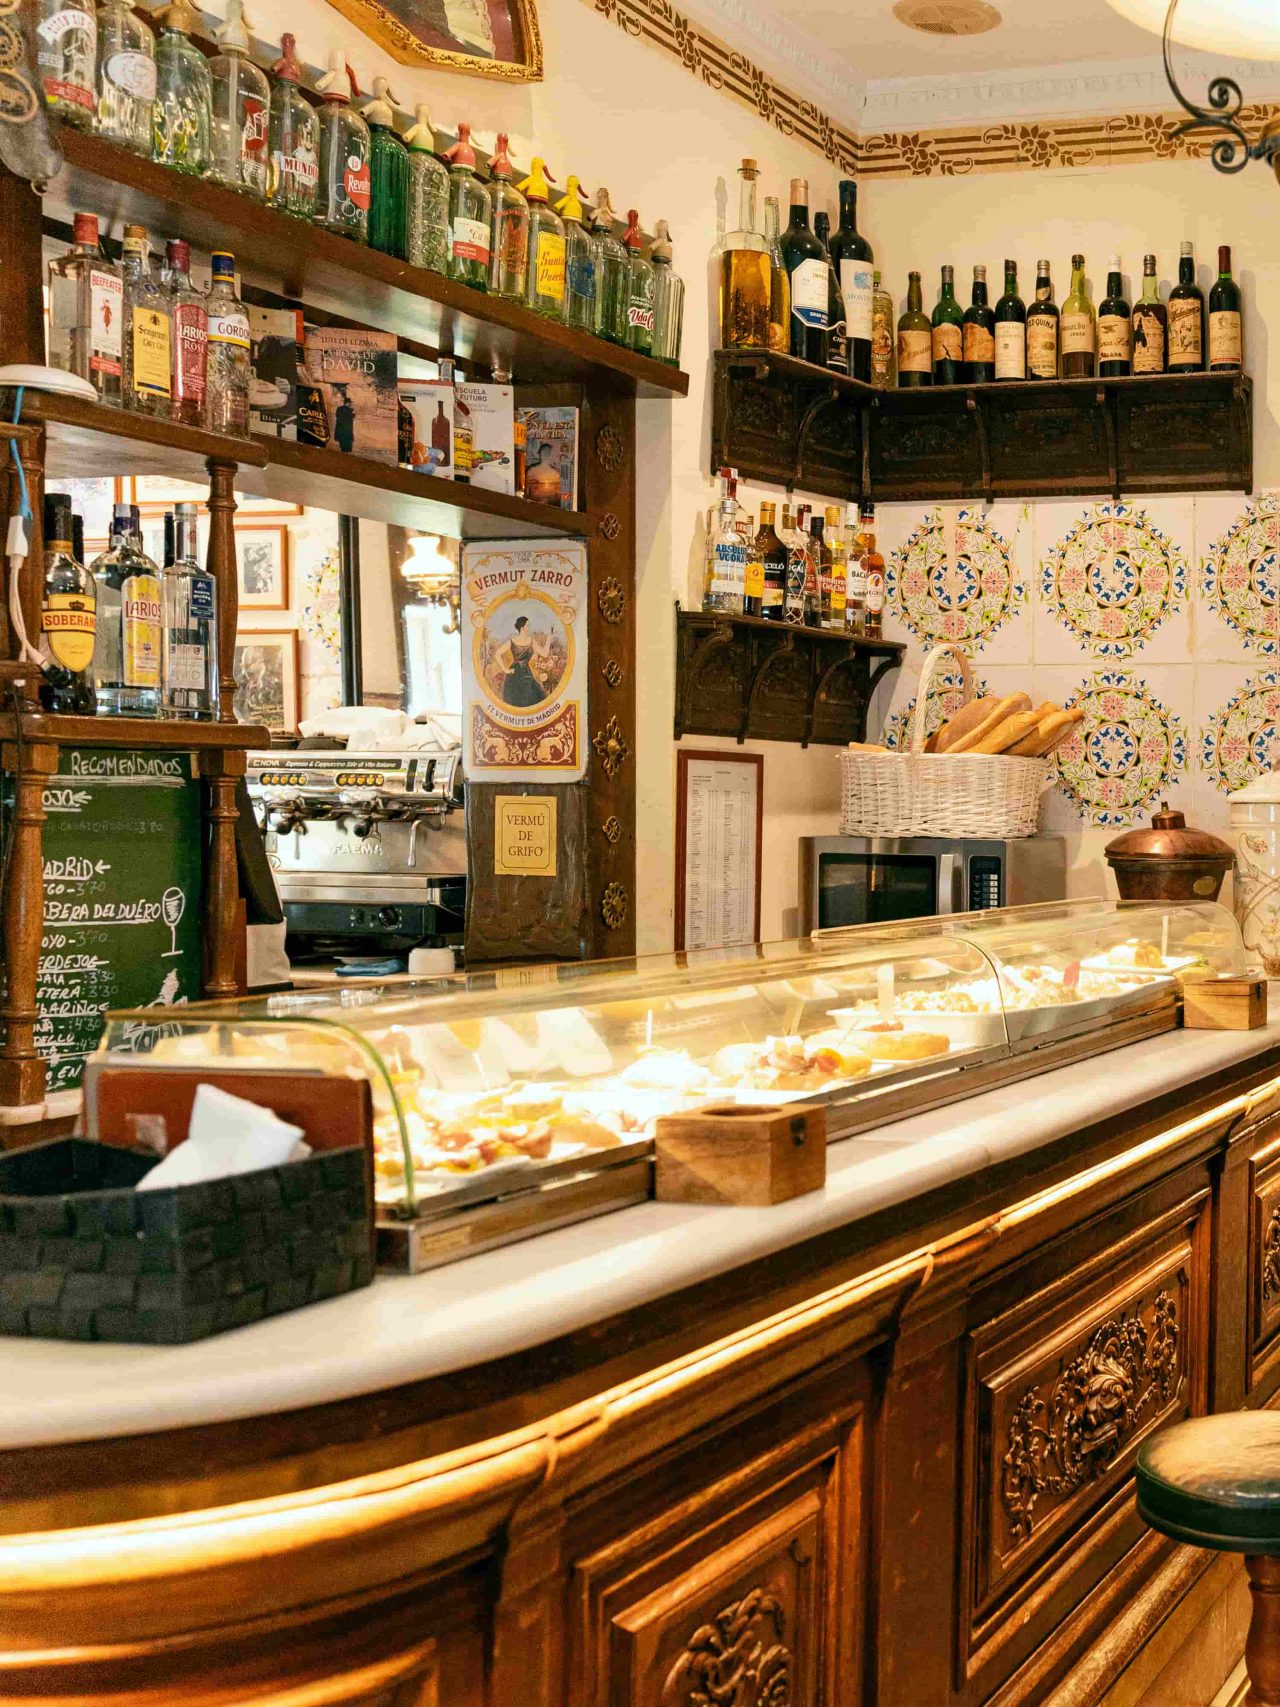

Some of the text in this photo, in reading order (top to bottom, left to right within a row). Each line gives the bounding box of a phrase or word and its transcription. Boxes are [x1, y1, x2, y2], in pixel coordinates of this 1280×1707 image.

[92, 274, 122, 292] BEEFEATER
[180, 324, 208, 343] LARIOS
[218, 322, 249, 340] GORDO
[363, 351, 377, 361] DE
[322, 358, 376, 373] DAVID
[460, 394, 488, 403] FUTURO
[716, 543, 745, 555] ABSOLU
[474, 568, 573, 592] VERMUT ZARRO
[125, 600, 161, 620] LARIOS
[43, 613, 96, 628] SOBERAN
[494, 710, 526, 726] VERMUT
[527, 717, 535, 726] DE
[535, 703, 561, 722] MADRID
[71, 751, 183, 776] RECOMENDADOS
[41, 789, 76, 806] OJA
[506, 812, 545, 826] VERMÚ
[518, 830, 534, 841] DE
[330, 842, 383, 857] FAEMA
[508, 846, 543, 857] GRIFO
[43, 856, 93, 878] ADRID
[43, 899, 161, 921] IBERA DEL DUERO
[33, 1032, 75, 1044] DELLO
